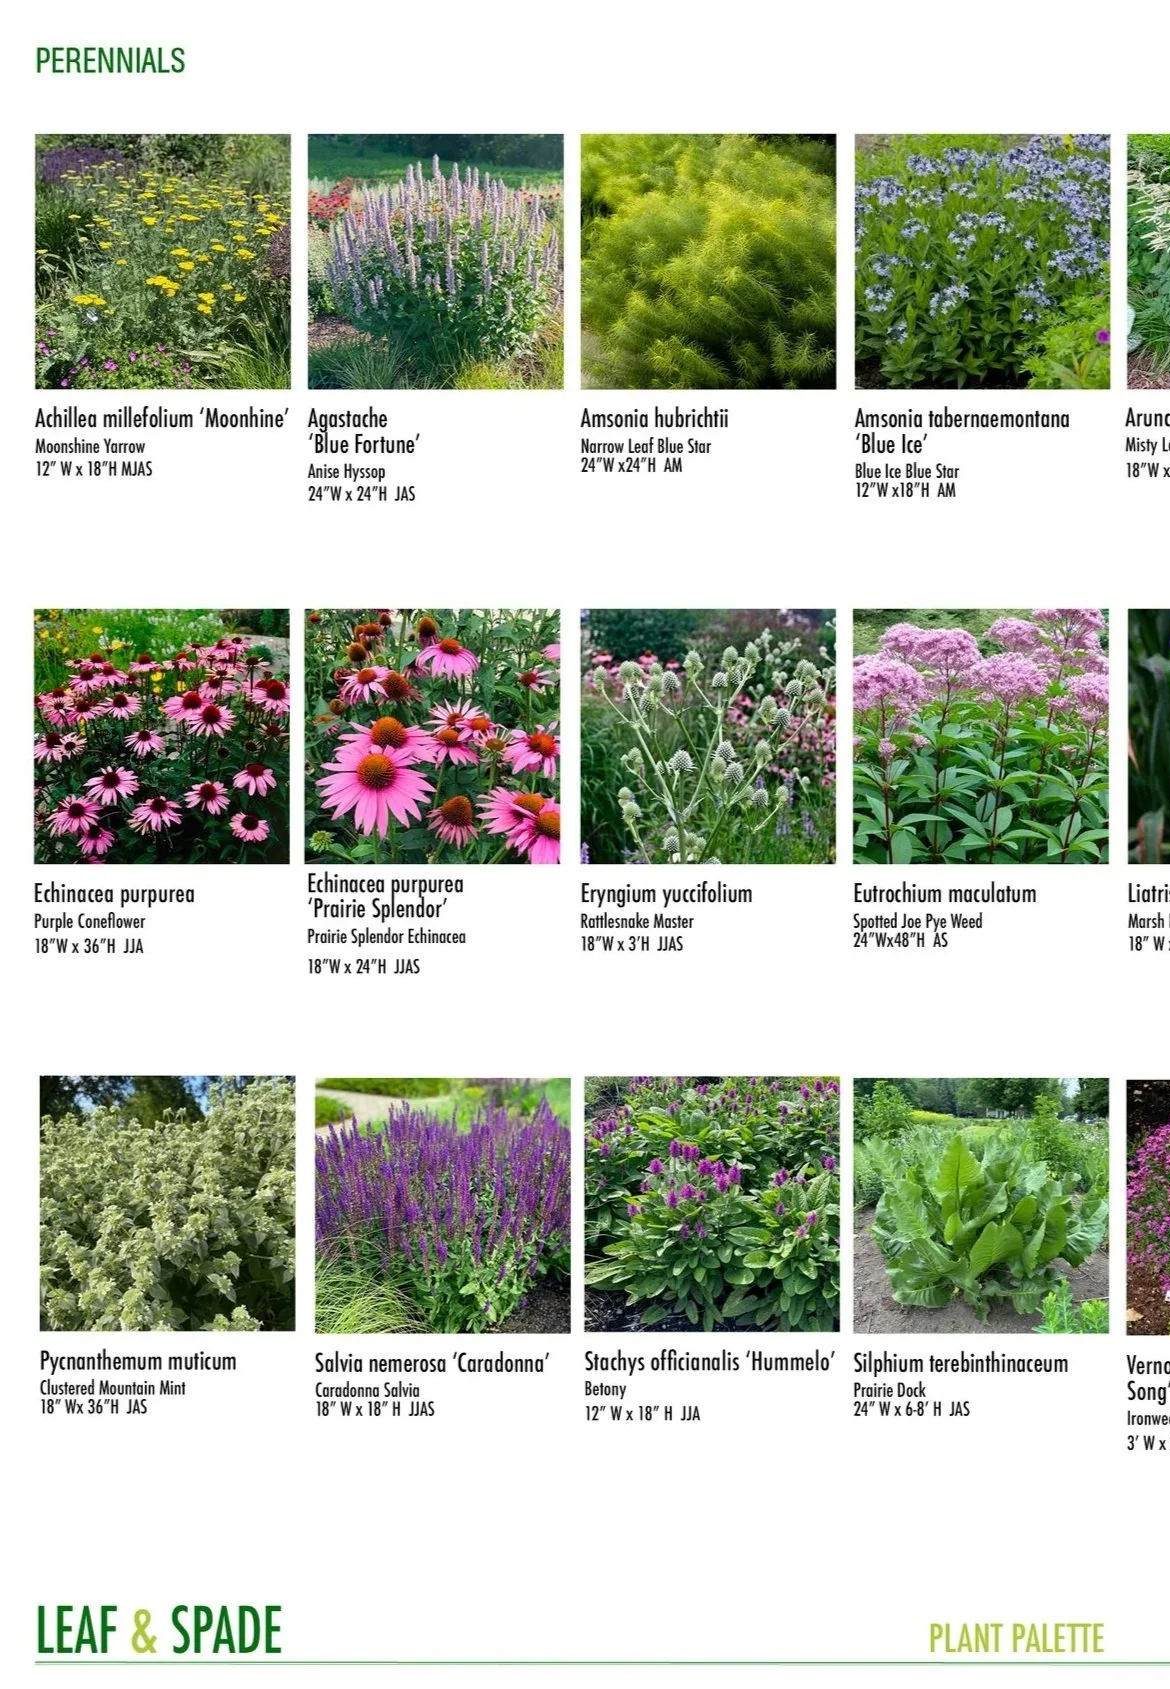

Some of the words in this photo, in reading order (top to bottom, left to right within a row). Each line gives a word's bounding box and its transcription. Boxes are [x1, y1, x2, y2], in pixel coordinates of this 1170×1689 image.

[36, 46, 186, 74] PERENNIALS
[34, 405, 97, 429] Achillea
[103, 405, 194, 429] millefolium
[306, 404, 389, 434] Agastache
[579, 407, 649, 429] Amsonia
[654, 405, 729, 429] hubrichtii
[854, 407, 923, 429] Amsonia
[927, 405, 1070, 429] tabernaemontana
[34, 436, 101, 454] Moonshine
[103, 437, 146, 454] Yarrow
[580, 437, 625, 454] Narrow
[628, 436, 655, 454] Leaf
[657, 436, 684, 454] Blue
[687, 437, 712, 454] Star
[1125, 436, 1159, 457] Misty
[307, 463, 340, 479] Anise
[343, 462, 386, 483] Hyssop
[855, 461, 882, 479] Blue
[884, 462, 902, 479] Ice
[905, 461, 932, 479] Blue
[935, 462, 960, 479] Star
[34, 880, 114, 904] Echinacea
[120, 888, 195, 909] purpurea
[307, 870, 385, 894] Echinacea
[390, 875, 465, 900] purpurea
[581, 882, 657, 909] Eryngium
[661, 880, 753, 909] yuccifolium
[853, 880, 942, 904] Eutrochium
[948, 880, 1037, 904] maculatum
[34, 911, 74, 933] Purple
[77, 911, 146, 929] Coneflower
[580, 911, 650, 929] Rattlesnake
[653, 912, 695, 929] Master
[852, 911, 898, 933] Spotted
[900, 912, 922, 929] Joe
[925, 912, 947, 933] Pye
[949, 911, 983, 929] Weed
[1127, 911, 1165, 929] Marsh
[71, 942, 80, 954] x
[122, 937, 144, 954] JJA
[307, 928, 348, 944] Prairie
[350, 926, 405, 948] Splendor
[407, 926, 467, 944] Echinacea
[40, 1347, 163, 1376] Pycnanthemum
[168, 1350, 237, 1371] muticum
[314, 1350, 363, 1373] Salvia
[368, 1358, 447, 1373] nemerosa
[584, 1348, 646, 1377] Stachys
[650, 1348, 740, 1372] officianalis
[853, 1350, 924, 1378] Silphium
[928, 1350, 1069, 1373] terebinthinaceum
[39, 1378, 95, 1396] Clustered
[98, 1379, 156, 1396] Mountain
[159, 1379, 187, 1396] Mint
[315, 1380, 380, 1398] Caradonna
[383, 1380, 420, 1398] Salvia
[584, 1380, 627, 1401] Betony
[853, 1381, 894, 1398] Prairie
[896, 1380, 927, 1398] Dock
[64, 1398, 84, 1415] Wx
[125, 1398, 148, 1415] JAS
[37, 1604, 118, 1654] LEAF
[130, 1608, 158, 1655] &
[171, 1604, 283, 1655] SPADE
[929, 1622, 1004, 1653] PLANT
[1011, 1622, 1105, 1653] PALETTE
